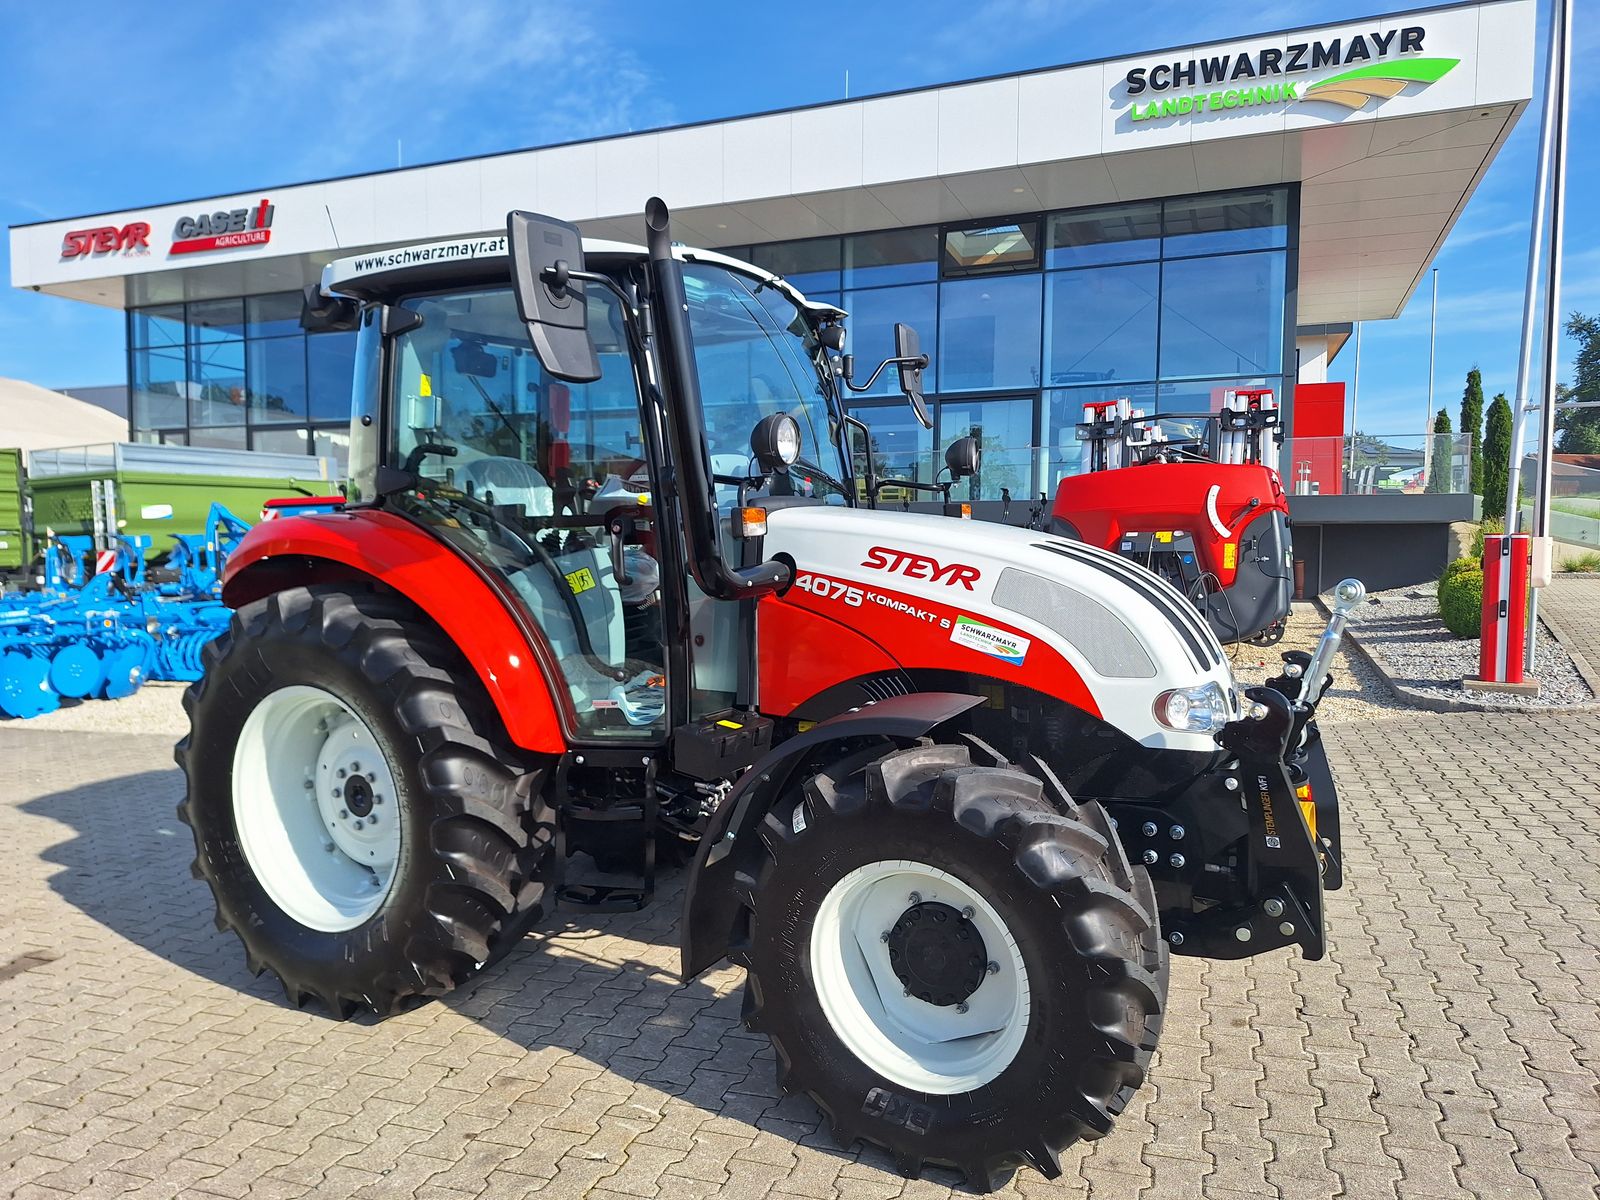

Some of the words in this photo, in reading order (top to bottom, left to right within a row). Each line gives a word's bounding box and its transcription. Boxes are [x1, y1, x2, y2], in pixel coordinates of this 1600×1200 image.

[1126, 26, 1426, 95] SCHWARZMAYR
[1131, 81, 1299, 122] LANDTECHNIK
[61, 222, 151, 258] STEYR
[175, 208, 248, 238] CASE
[214, 231, 266, 248] AGRICULTURE
[354, 236, 506, 272] www.schwarzmayr.at
[860, 546, 981, 592] STEYR
[795, 574, 864, 608] 4075
[866, 591, 937, 624] KOMPAKT
[939, 618, 951, 630] S
[961, 624, 1017, 648] SCHWARZMAYR
[1260, 791, 1277, 835] STEMPLINGER
